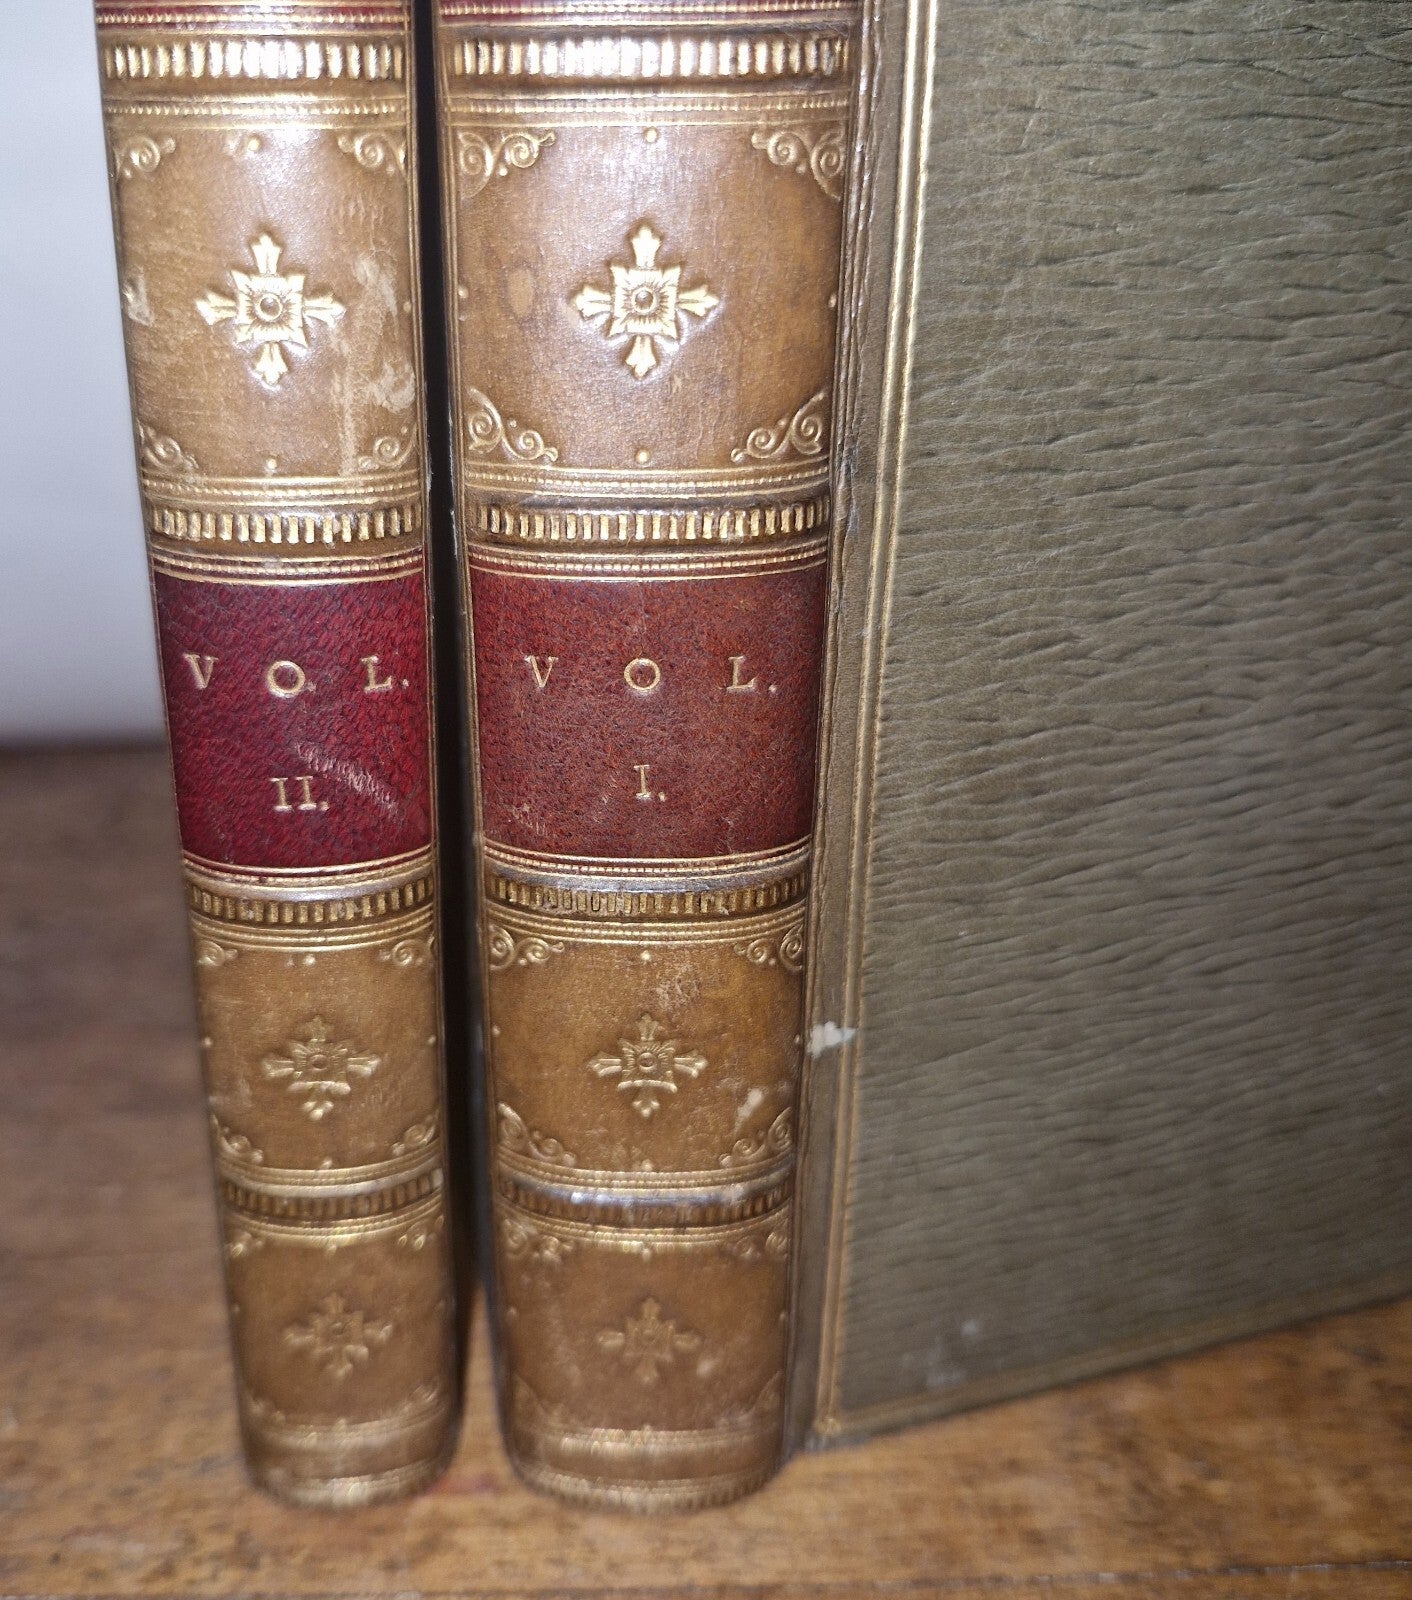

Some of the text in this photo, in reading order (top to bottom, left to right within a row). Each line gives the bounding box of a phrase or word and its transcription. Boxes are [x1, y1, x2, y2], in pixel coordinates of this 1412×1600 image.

[182, 653, 410, 698] VOL.
[523, 655, 778, 694] VOL.
[270, 775, 330, 812] II.
[633, 764, 666, 802] I.
